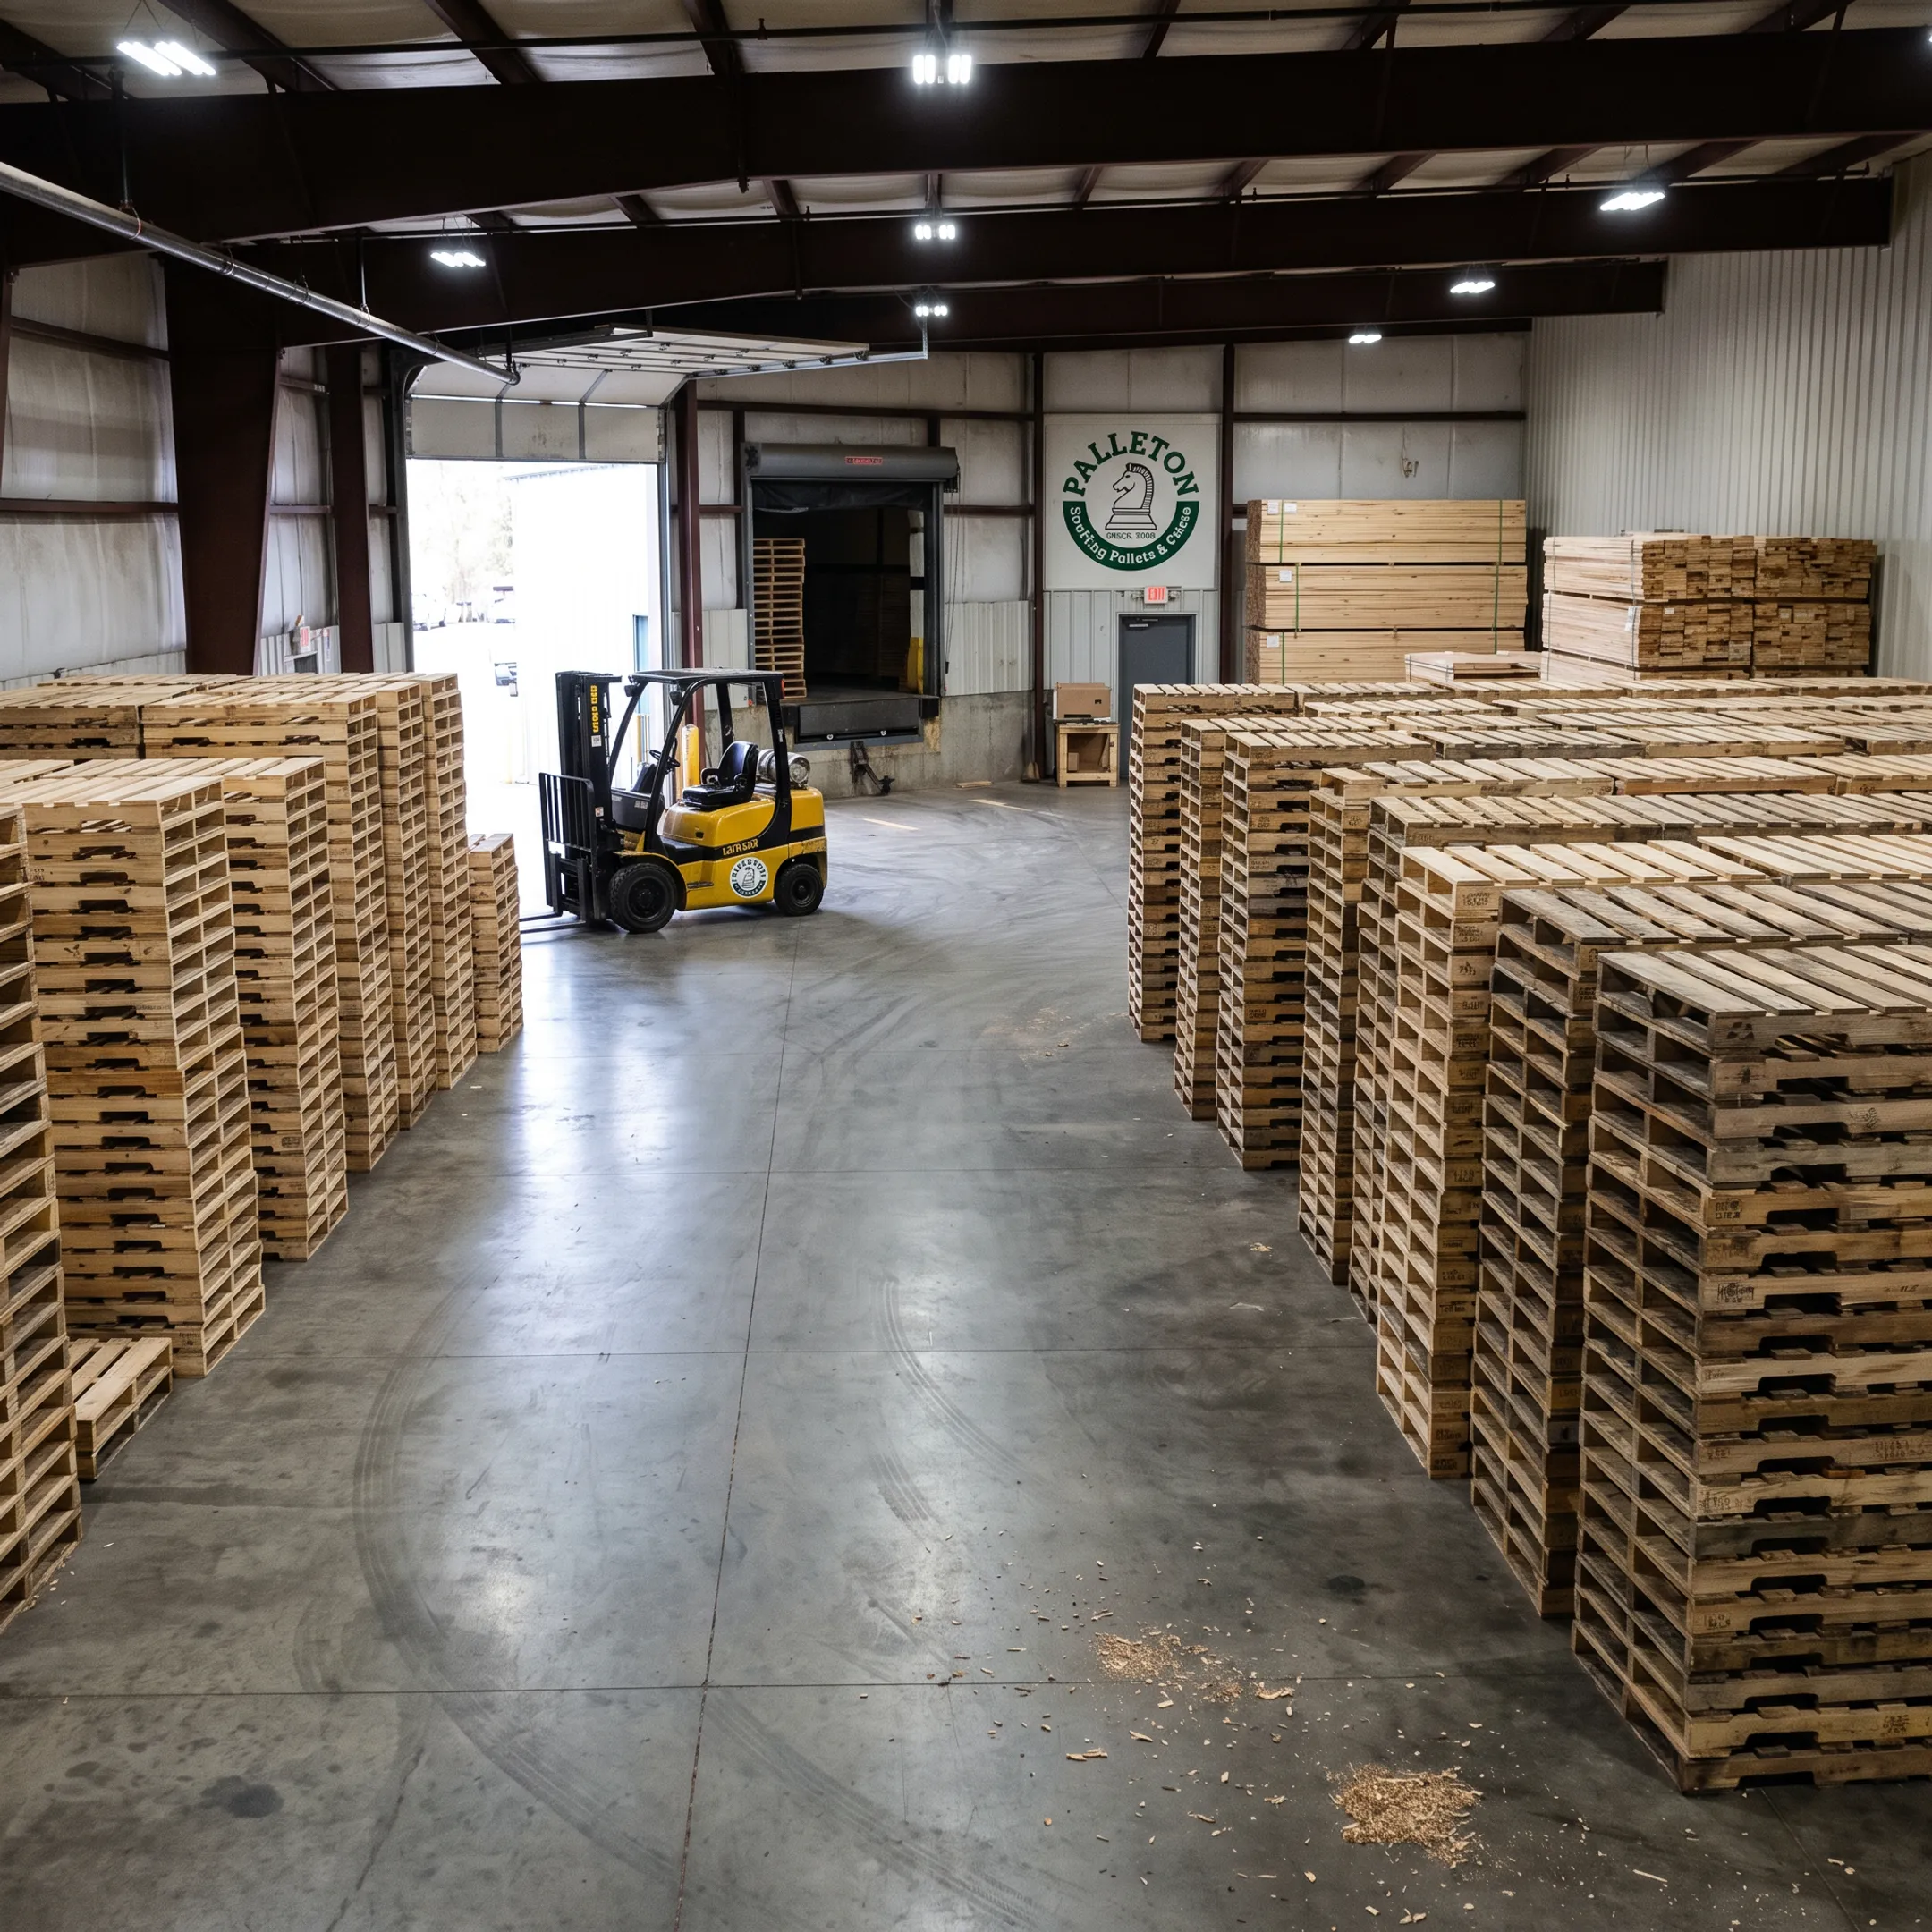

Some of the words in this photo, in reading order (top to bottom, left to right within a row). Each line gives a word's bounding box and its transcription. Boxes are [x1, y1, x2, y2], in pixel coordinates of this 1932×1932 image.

[1063, 430, 1199, 497] PALLETON
[1109, 549, 1156, 564] Pallets
[1157, 543, 1168, 555] &
